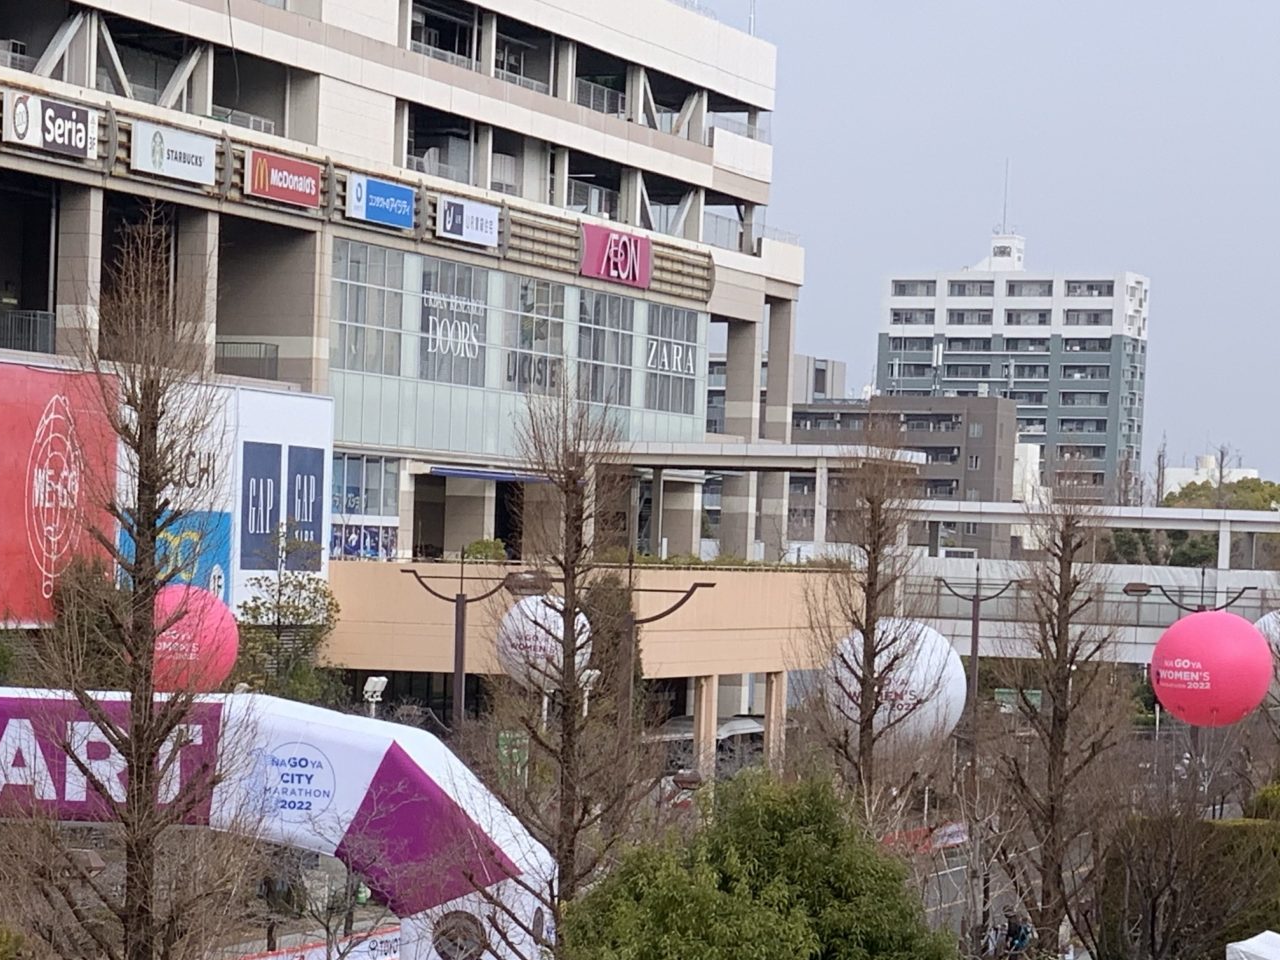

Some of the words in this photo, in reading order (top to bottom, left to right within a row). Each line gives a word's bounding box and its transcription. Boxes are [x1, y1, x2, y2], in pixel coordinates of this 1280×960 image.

[44, 107, 86, 149] Seria
[166, 148, 203, 168] STARBUCKS
[270, 168, 316, 196] McDonald's
[428, 316, 479, 359] DOORS
[647, 340, 695, 374] ZARA
[248, 478, 274, 535] GAP
[294, 474, 316, 523] GAP
[1164, 658, 1202, 669] NAGOYA
[1159, 669, 1211, 682] WOMEN'S
[1186, 681, 1212, 690] 2022
[271, 756, 324, 769] NAGOYA
[280, 772, 315, 785] CITY
[264, 786, 331, 799] MARATHON
[280, 799, 312, 811] 2022
